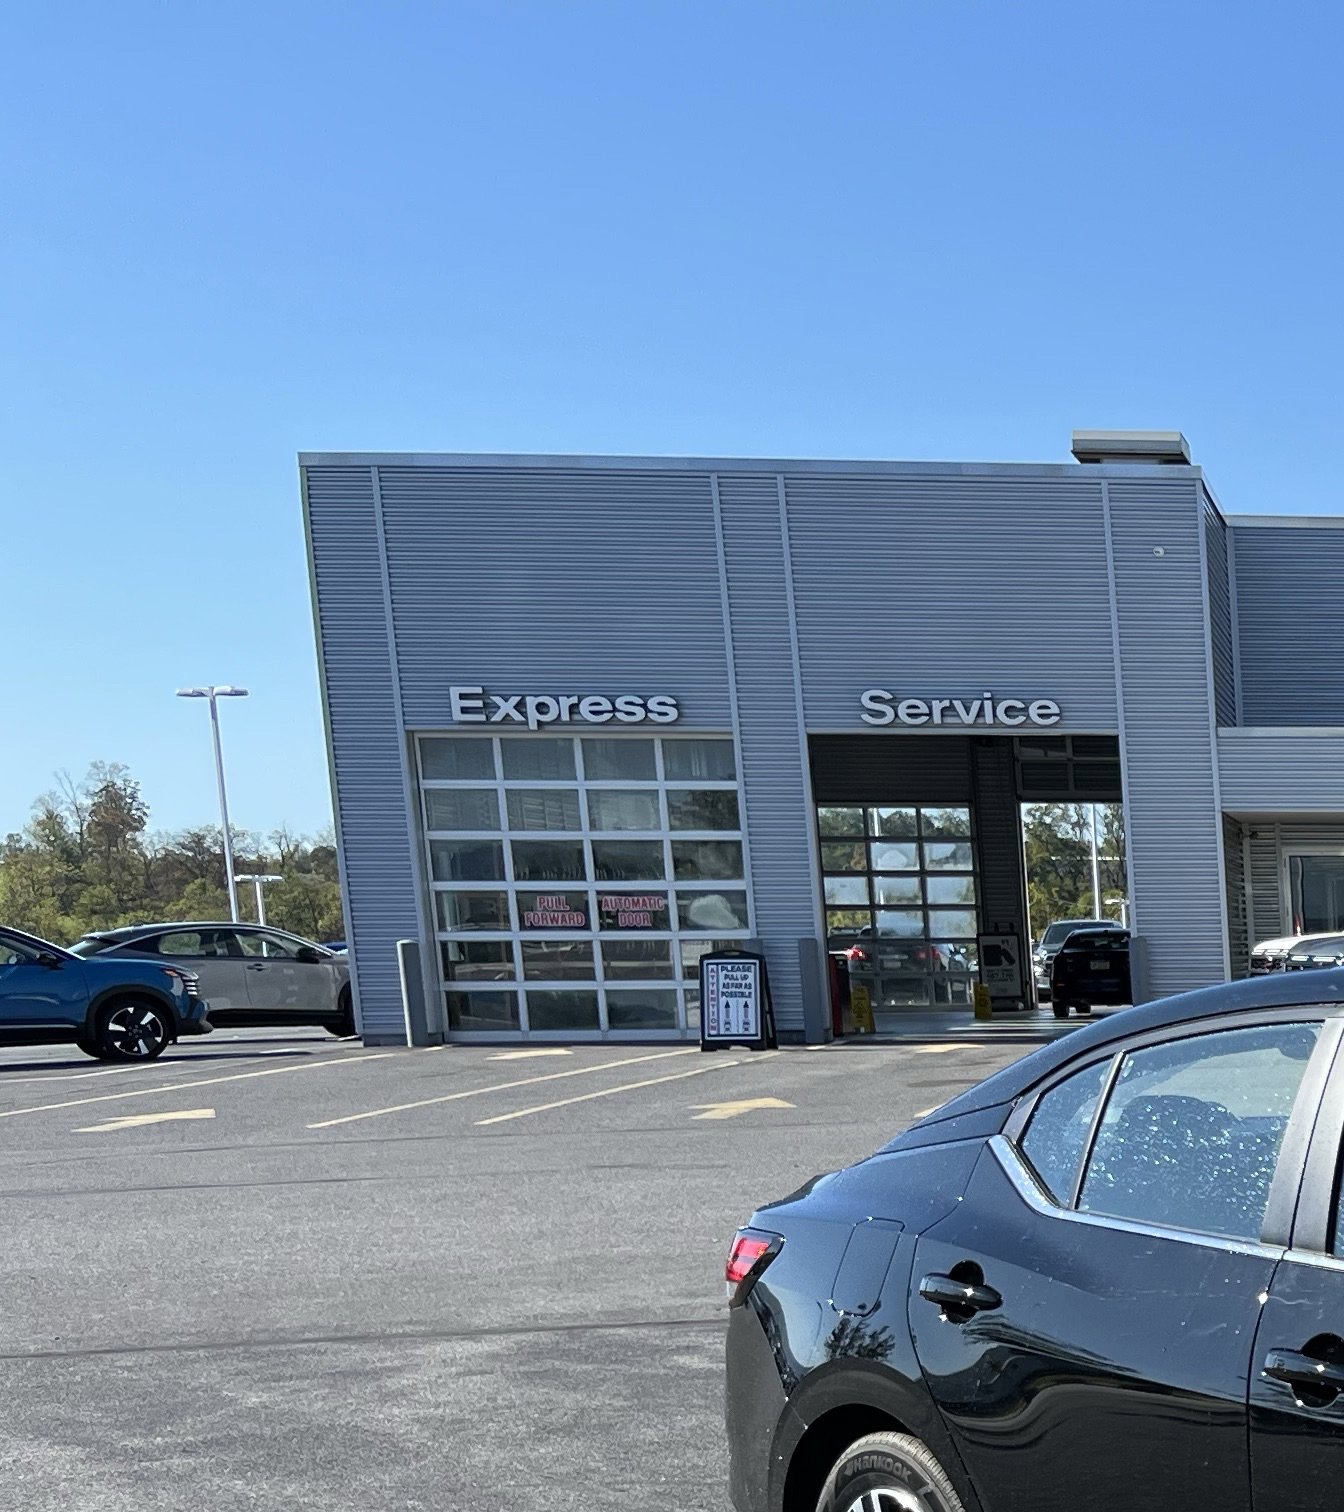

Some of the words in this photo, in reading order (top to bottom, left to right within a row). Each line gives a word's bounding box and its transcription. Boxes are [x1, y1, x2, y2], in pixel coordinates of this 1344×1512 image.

[449, 686, 679, 731] Express
[860, 689, 1061, 726] Service
[537, 896, 570, 911] PULL
[602, 896, 665, 911] AUTOMATIC
[525, 912, 586, 926] FORWARD
[618, 912, 652, 926] DOOR
[721, 965, 752, 973] PLEASE
[709, 968, 717, 1031] ATTENTION
[721, 991, 752, 999] POSSIBLE
